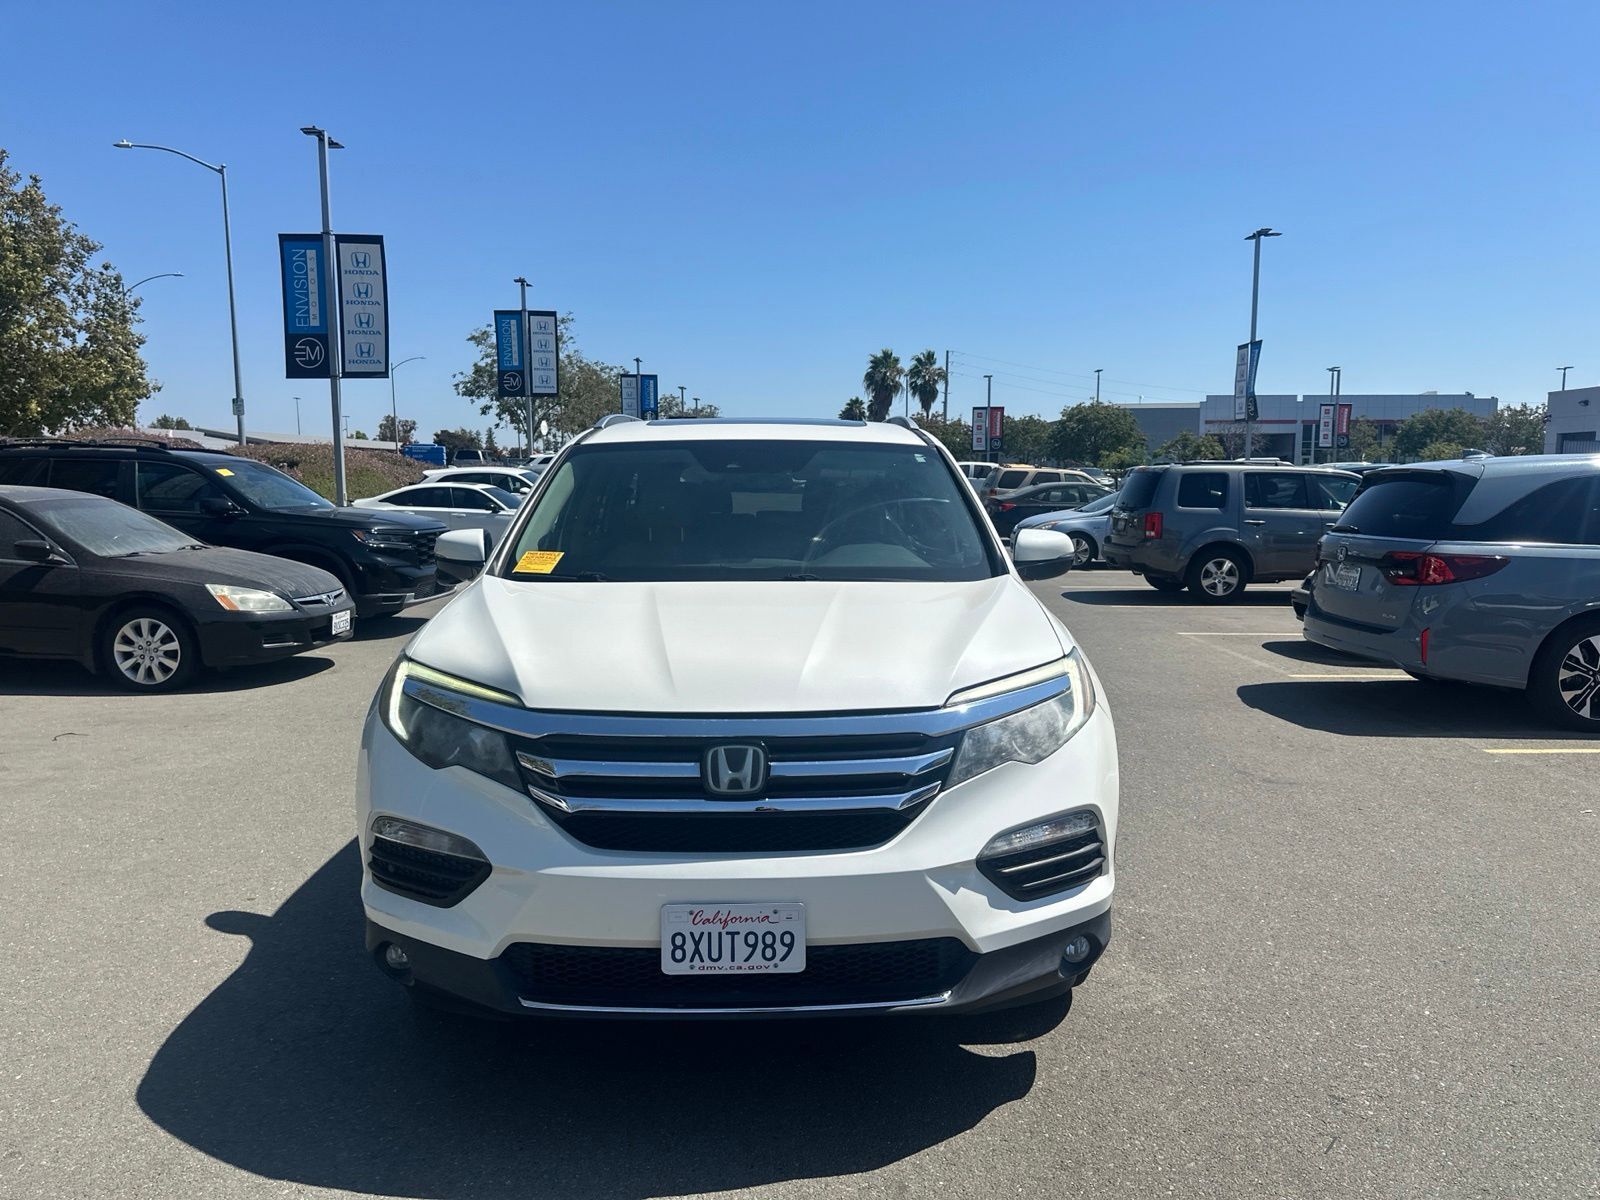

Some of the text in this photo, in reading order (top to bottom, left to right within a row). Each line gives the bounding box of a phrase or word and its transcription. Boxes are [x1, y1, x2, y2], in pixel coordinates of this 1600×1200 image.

[292, 249, 310, 327] ENVISION
[309, 256, 318, 320] MOTORS
[502, 319, 513, 367] ENVISION
[692, 909, 779, 930] California
[670, 930, 795, 964] 8XUT989
[698, 963, 771, 972] dmv.ca.gov
